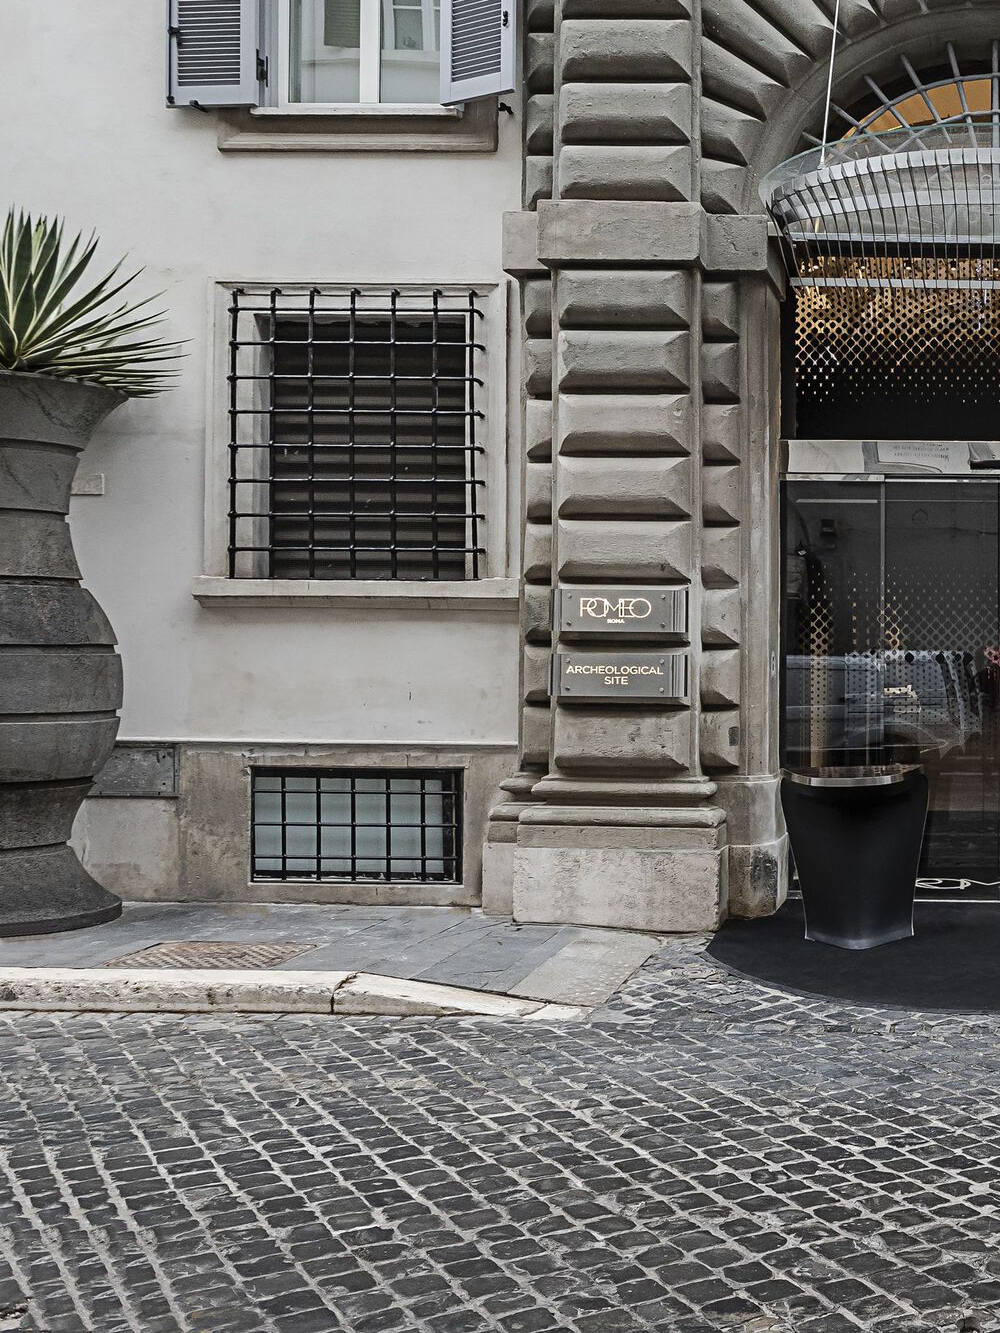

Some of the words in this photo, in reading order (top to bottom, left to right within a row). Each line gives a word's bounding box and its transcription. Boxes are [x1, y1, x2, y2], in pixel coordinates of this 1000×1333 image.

[580, 597, 652, 618] ROMEO
[566, 665, 664, 675] ARCHEOLOGICAL
[604, 677, 629, 685] SITE
